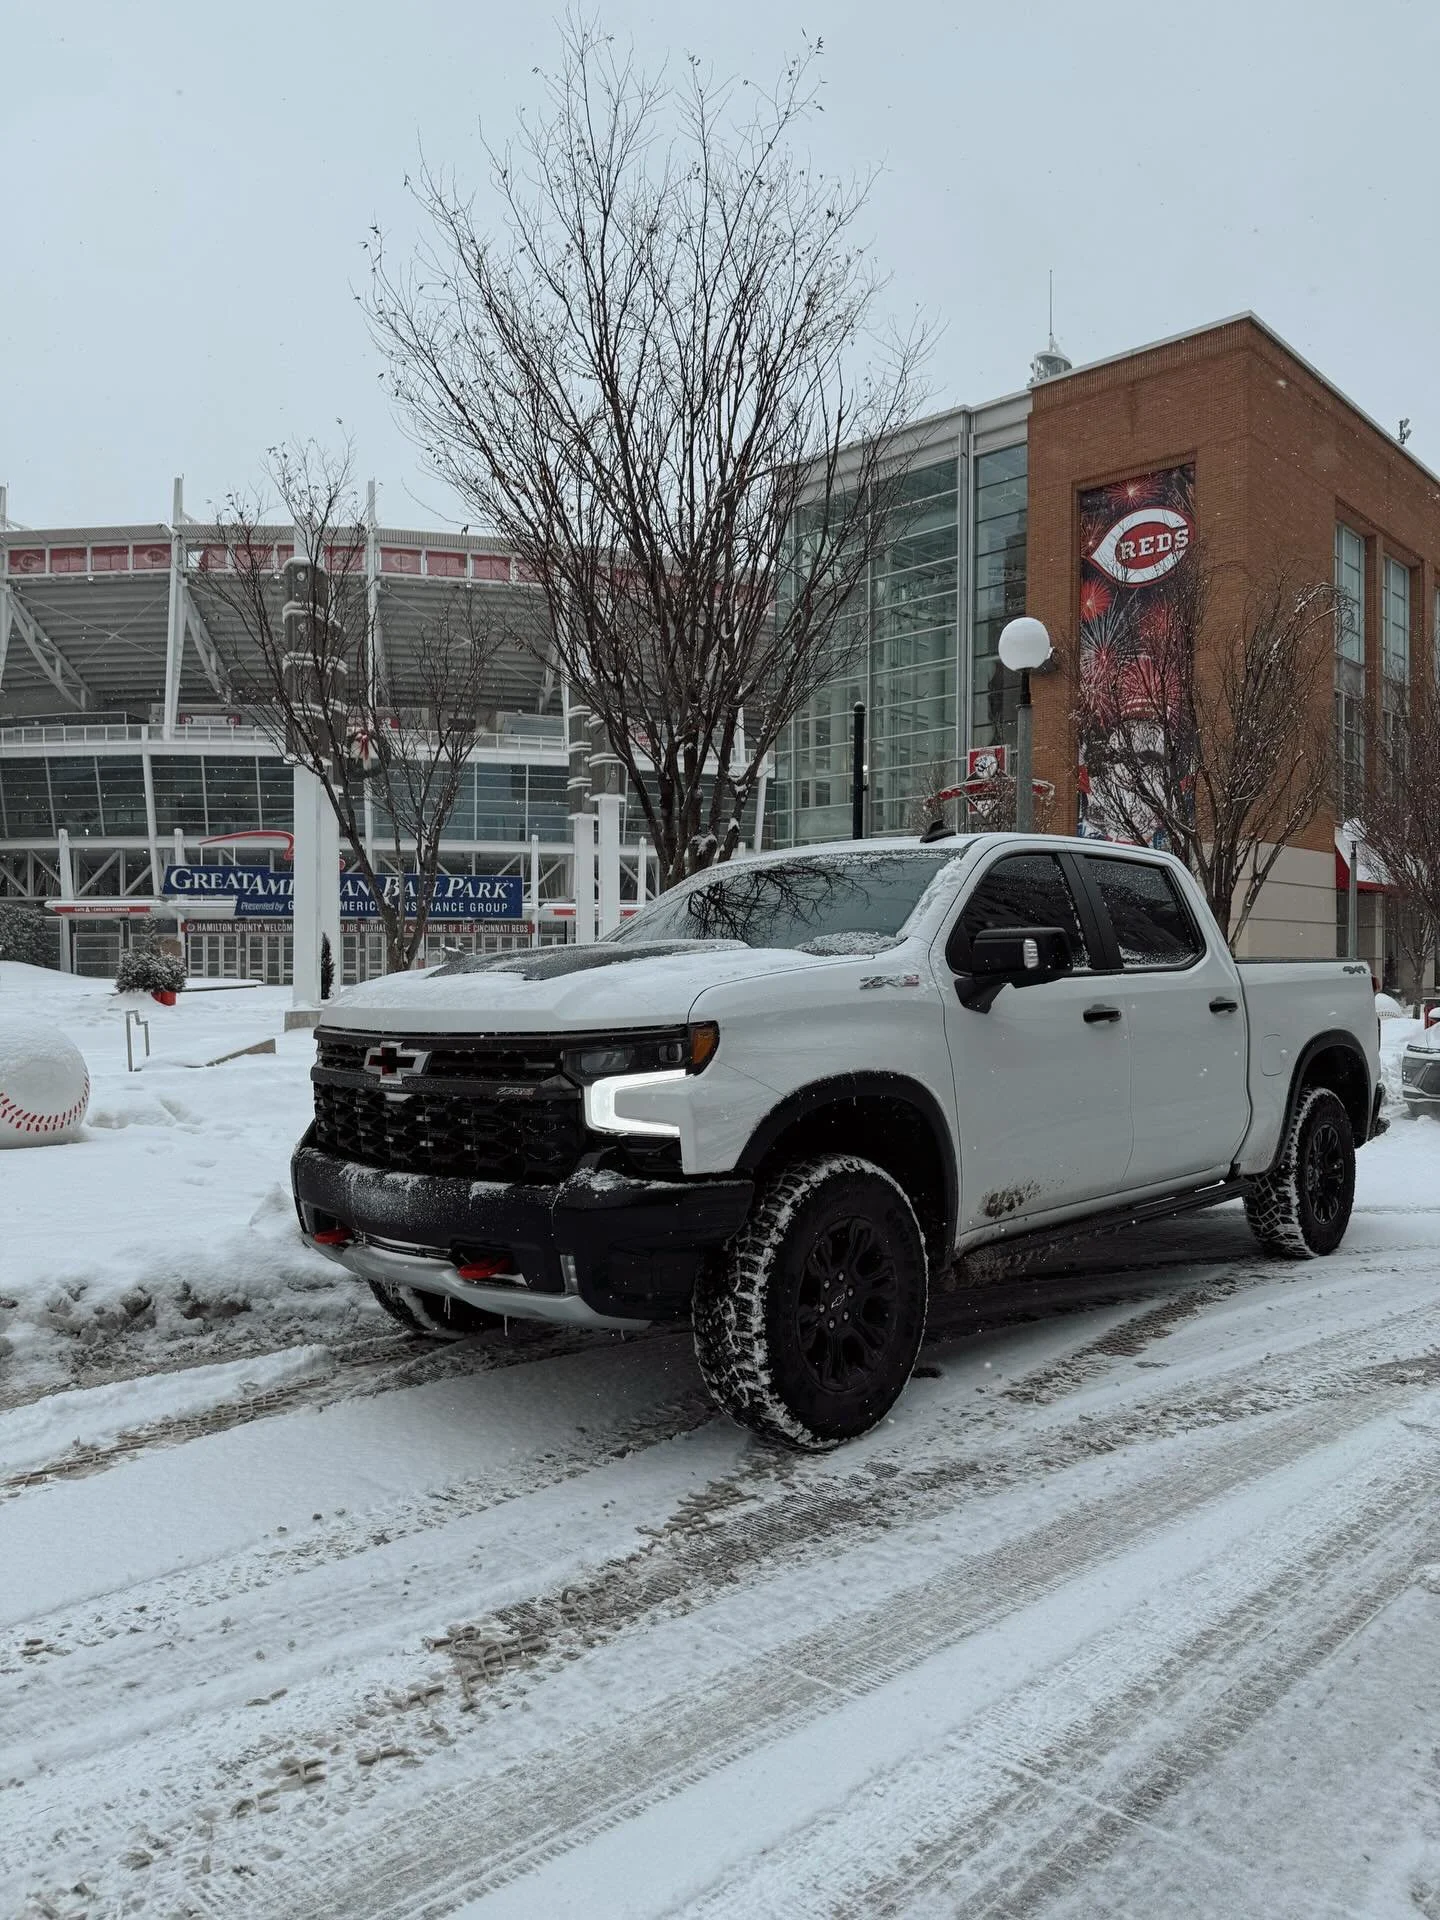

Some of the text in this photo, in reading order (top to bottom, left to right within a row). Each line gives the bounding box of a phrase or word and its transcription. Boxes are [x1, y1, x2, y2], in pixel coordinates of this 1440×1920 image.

[1119, 528, 1189, 561] REDS
[170, 868, 254, 890] GREAT
[445, 877, 510, 899] PARK
[240, 901, 275, 911] Presented
[275, 901, 286, 912] by
[469, 902, 508, 913] GROUP
[197, 923, 233, 932] HAMILTON
[234, 923, 262, 932] COUNTY
[263, 923, 293, 932] WELCOM
[427, 924, 447, 933] HOME
[448, 924, 456, 933] OF
[459, 924, 474, 933] THE
[474, 924, 510, 933] CINCINNATI
[511, 924, 528, 933] REDS
